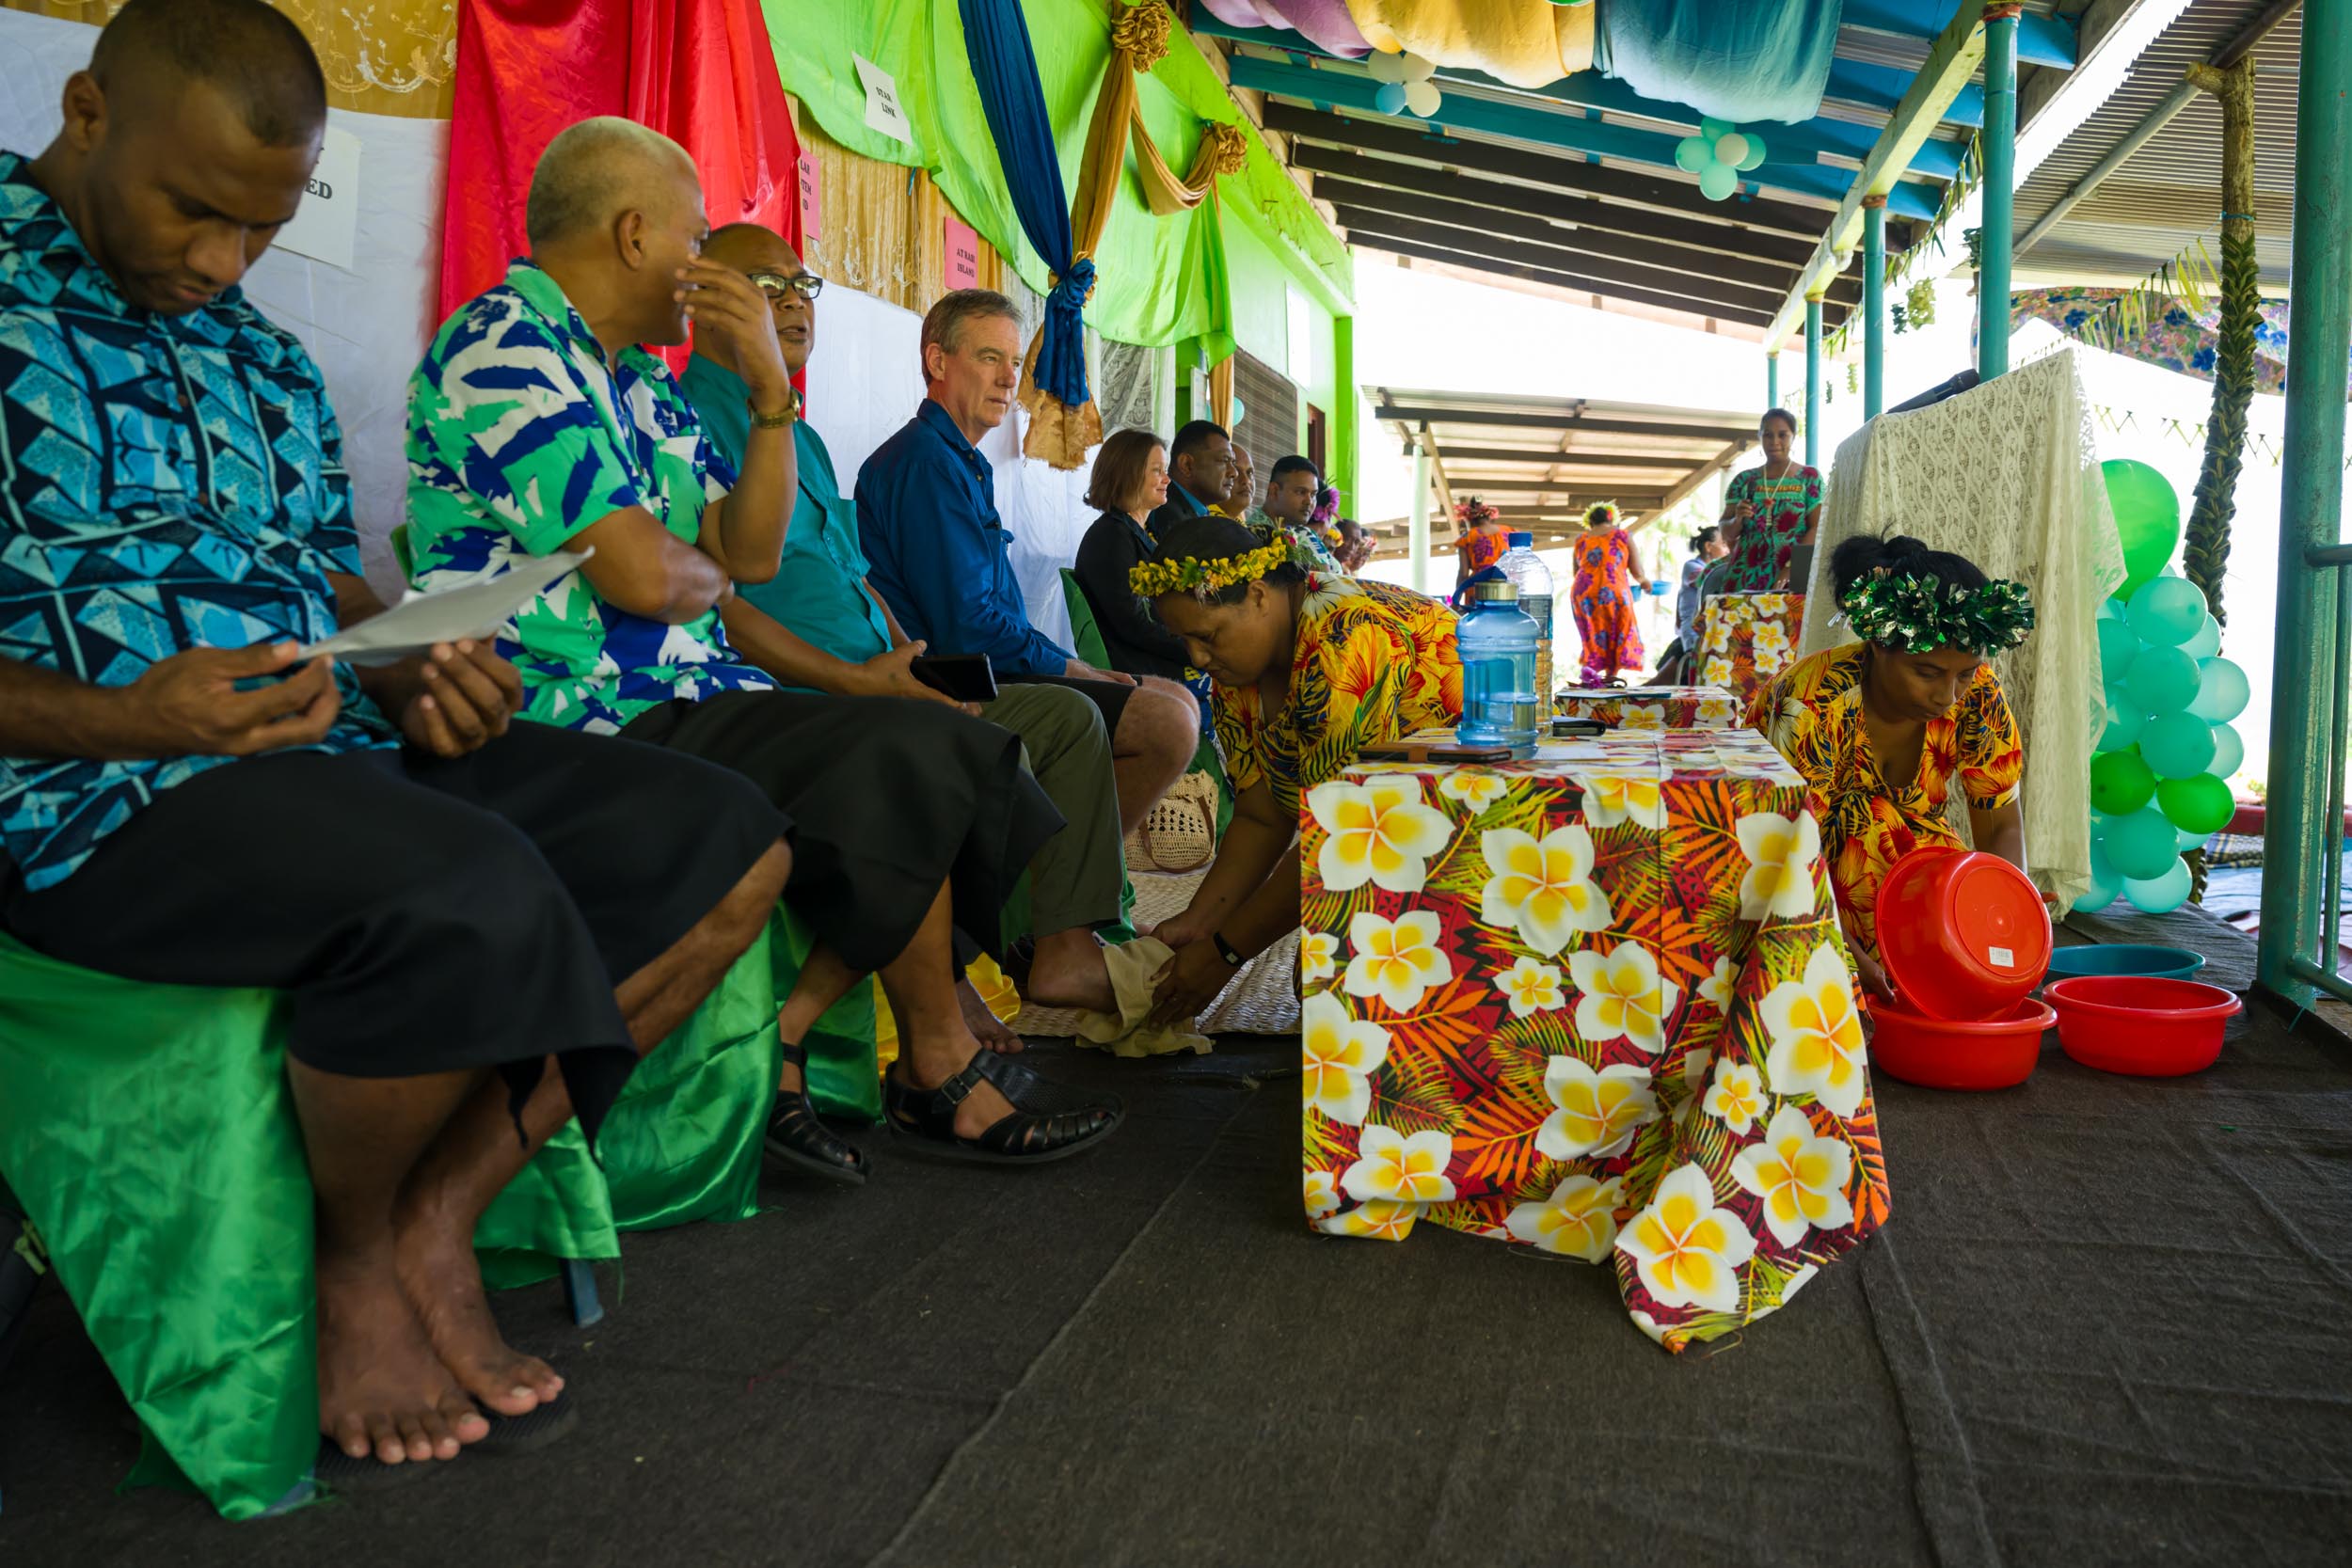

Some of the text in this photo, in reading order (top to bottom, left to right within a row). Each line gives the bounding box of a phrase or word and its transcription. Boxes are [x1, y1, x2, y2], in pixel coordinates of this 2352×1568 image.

[882, 102, 897, 119] LINK
[800, 159, 810, 175] LAR
[305, 178, 332, 199] ED
[801, 179, 812, 196] TEM
[957, 248, 963, 258] AT
[957, 262, 975, 278] ISLAND
